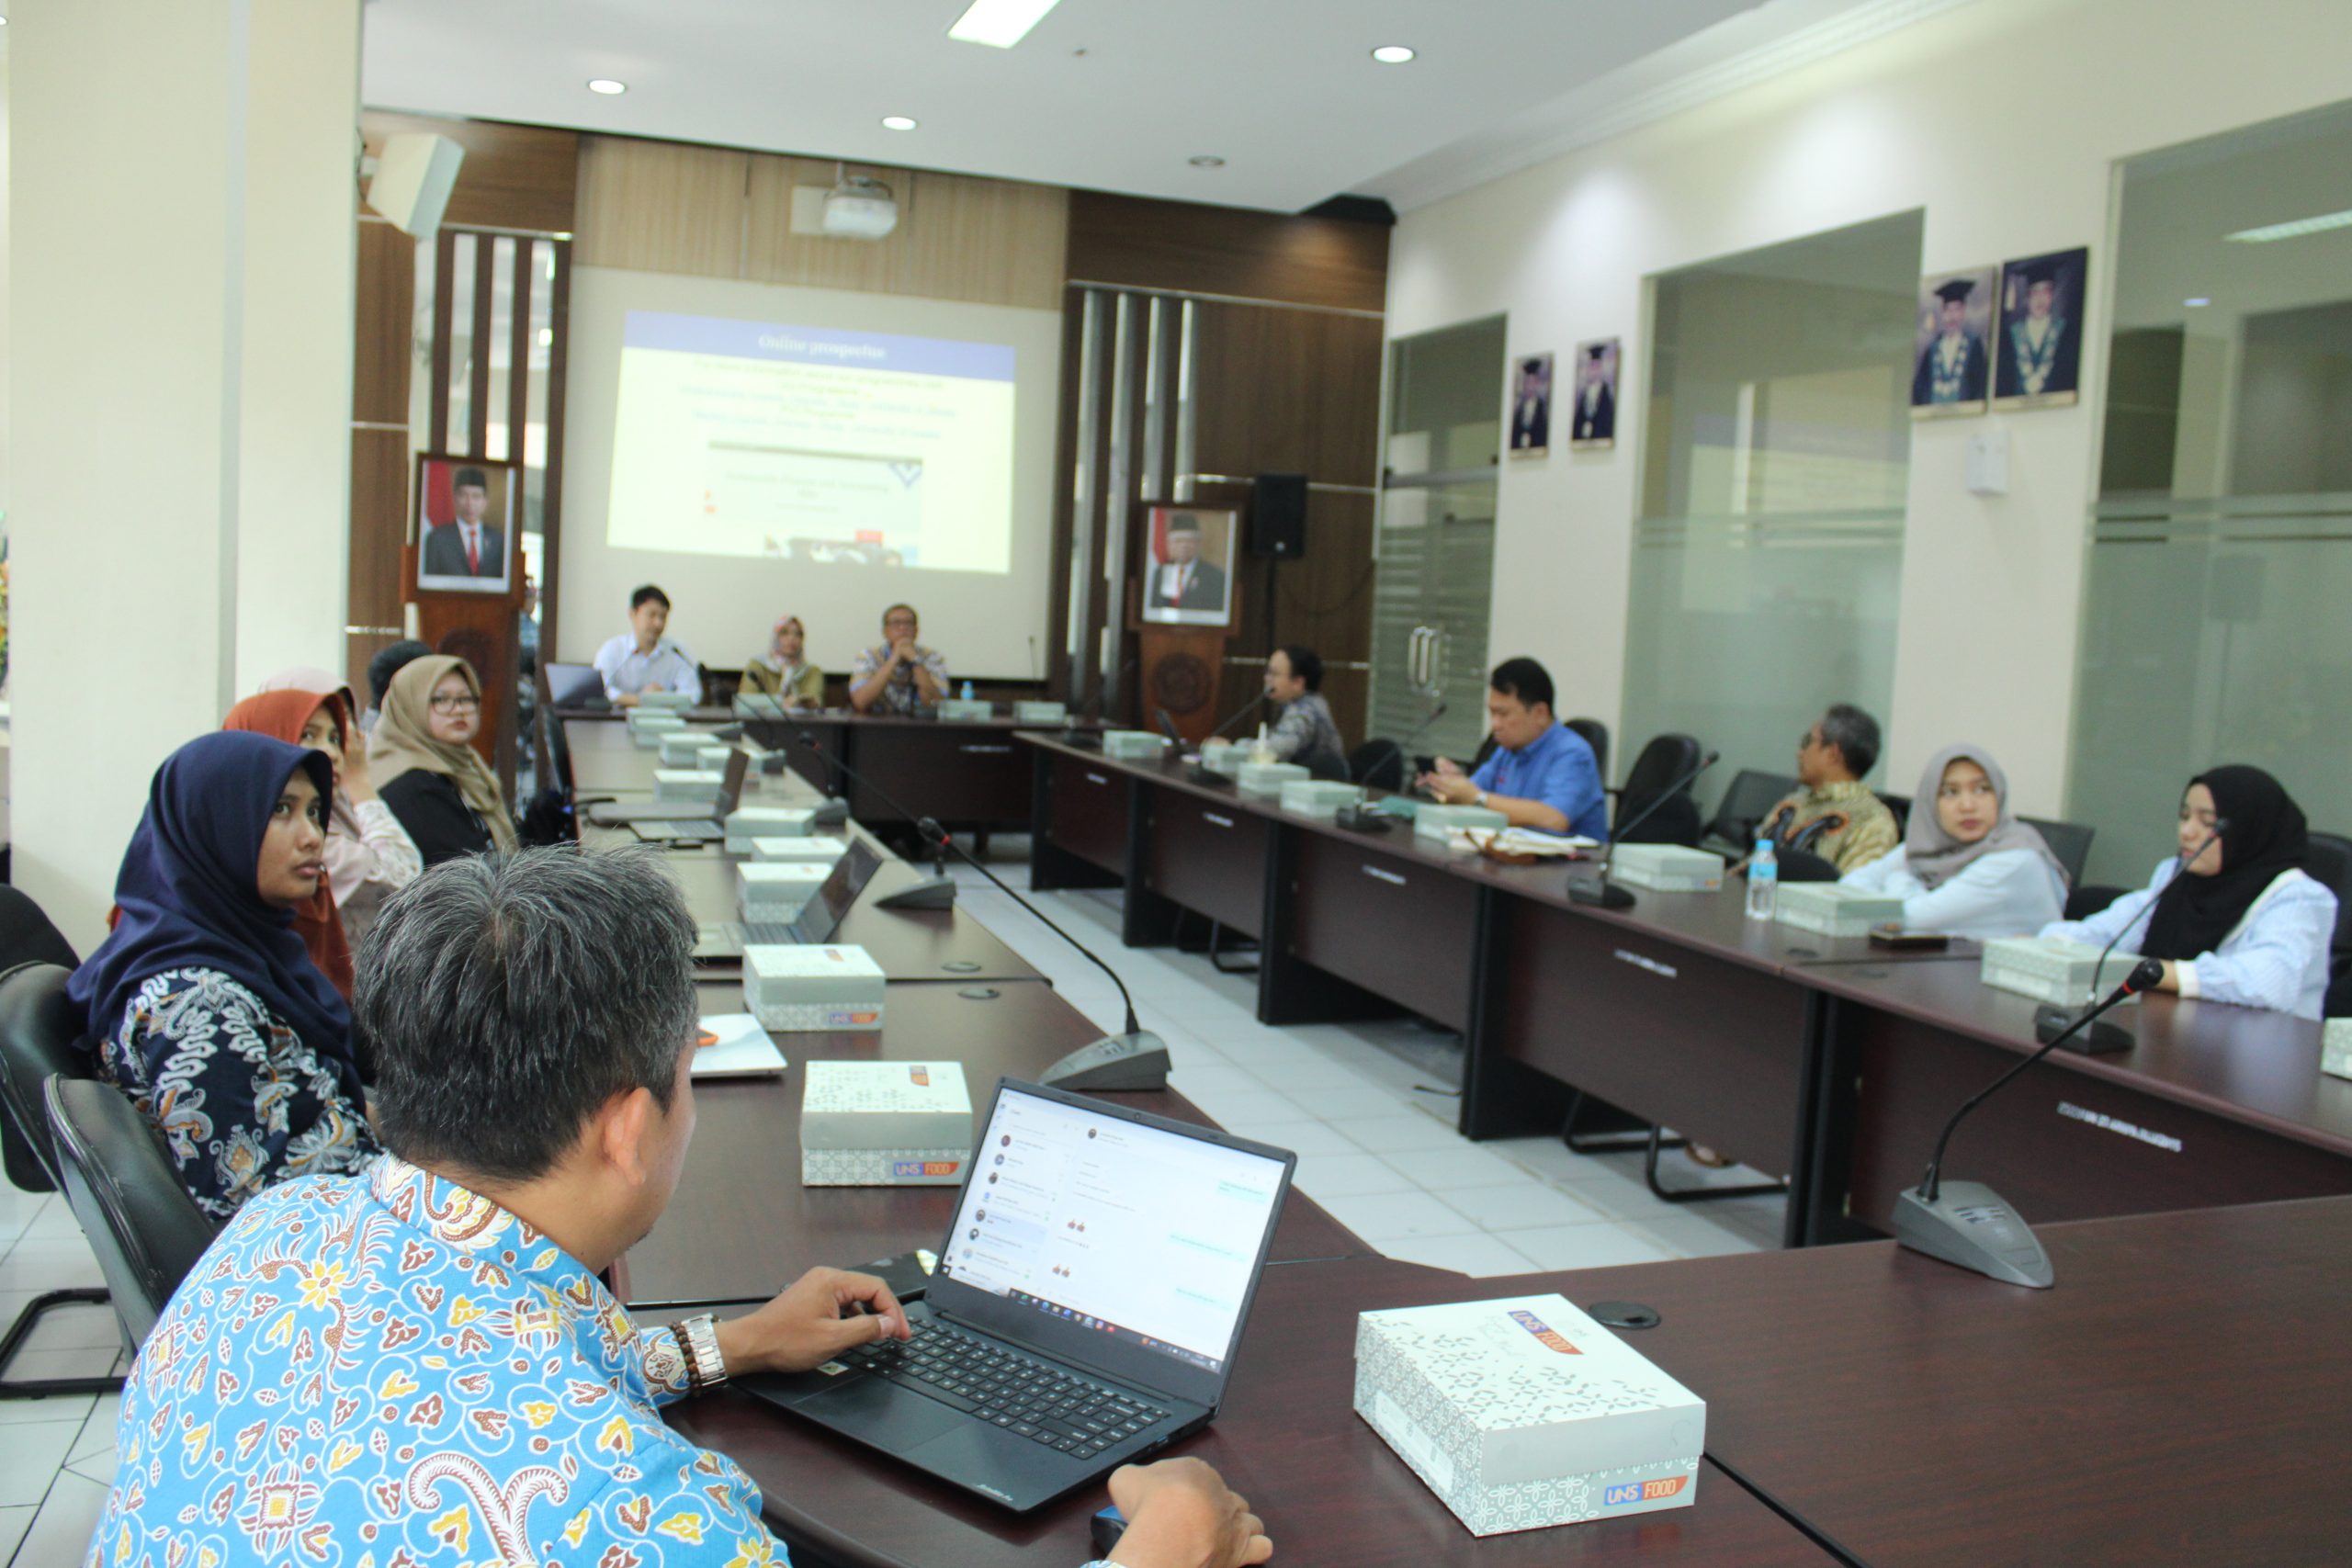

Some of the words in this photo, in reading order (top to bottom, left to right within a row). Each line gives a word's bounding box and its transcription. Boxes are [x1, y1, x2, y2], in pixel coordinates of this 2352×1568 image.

[758, 333, 808, 354] Online
[808, 340, 888, 362] prospectus
[896, 1163, 920, 1176] UNS
[925, 1163, 950, 1176] FOOD
[1535, 1331, 1573, 1351] FOOD
[1607, 1484, 1640, 1505] UNS
[1644, 1479, 1677, 1499] FOOD
